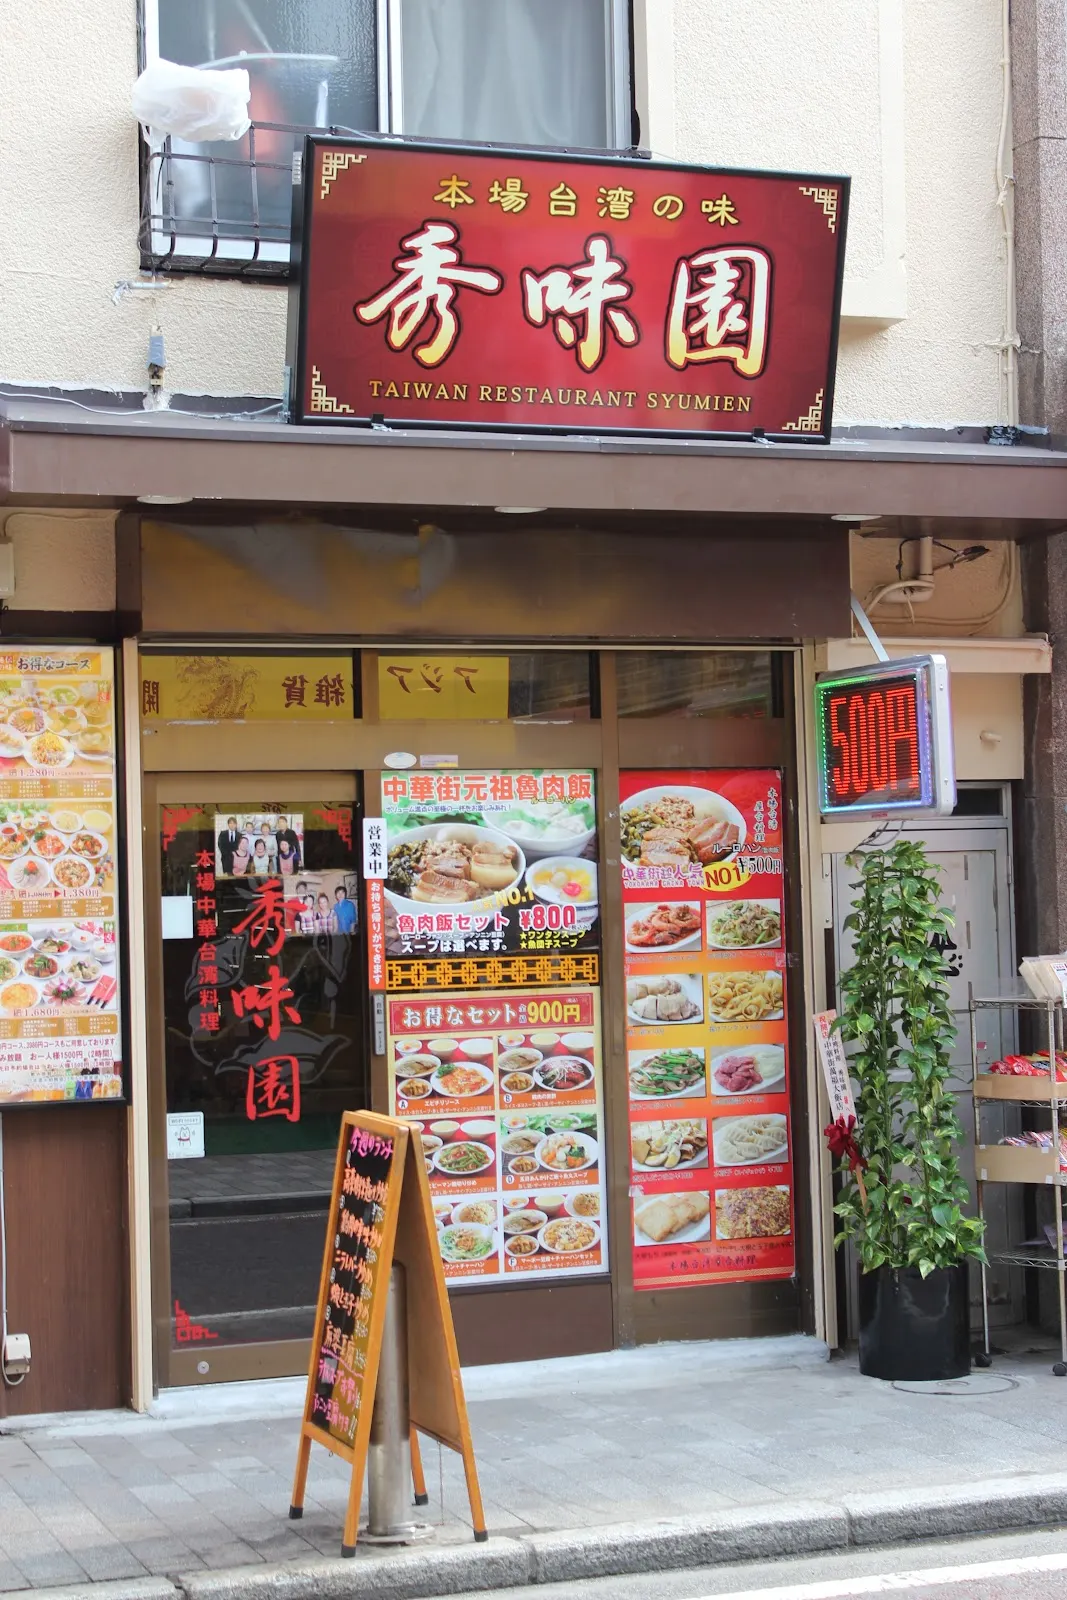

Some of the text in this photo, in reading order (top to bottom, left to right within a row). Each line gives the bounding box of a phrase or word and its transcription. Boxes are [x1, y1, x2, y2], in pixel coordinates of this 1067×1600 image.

[434, 174, 739, 227] 本場台湾の味
[356, 220, 775, 379] 秀味園
[369, 380, 752, 413] TAIWAN RESTAURANT SYUMIEN
[17, 656, 91, 671] お得なコース
[383, 774, 592, 802] 中華街元祖魯肉飯
[367, 825, 383, 875] 営業中
[195, 849, 220, 1031] 本場中華台湾料理
[370, 881, 384, 985] お持ち帰りができます
[397, 912, 510, 933] 魯肉飯セット
[401, 938, 508, 953] スープは選べます。
[231, 879, 308, 1122] 秀味園
[403, 1004, 517, 1028] お得なセット
